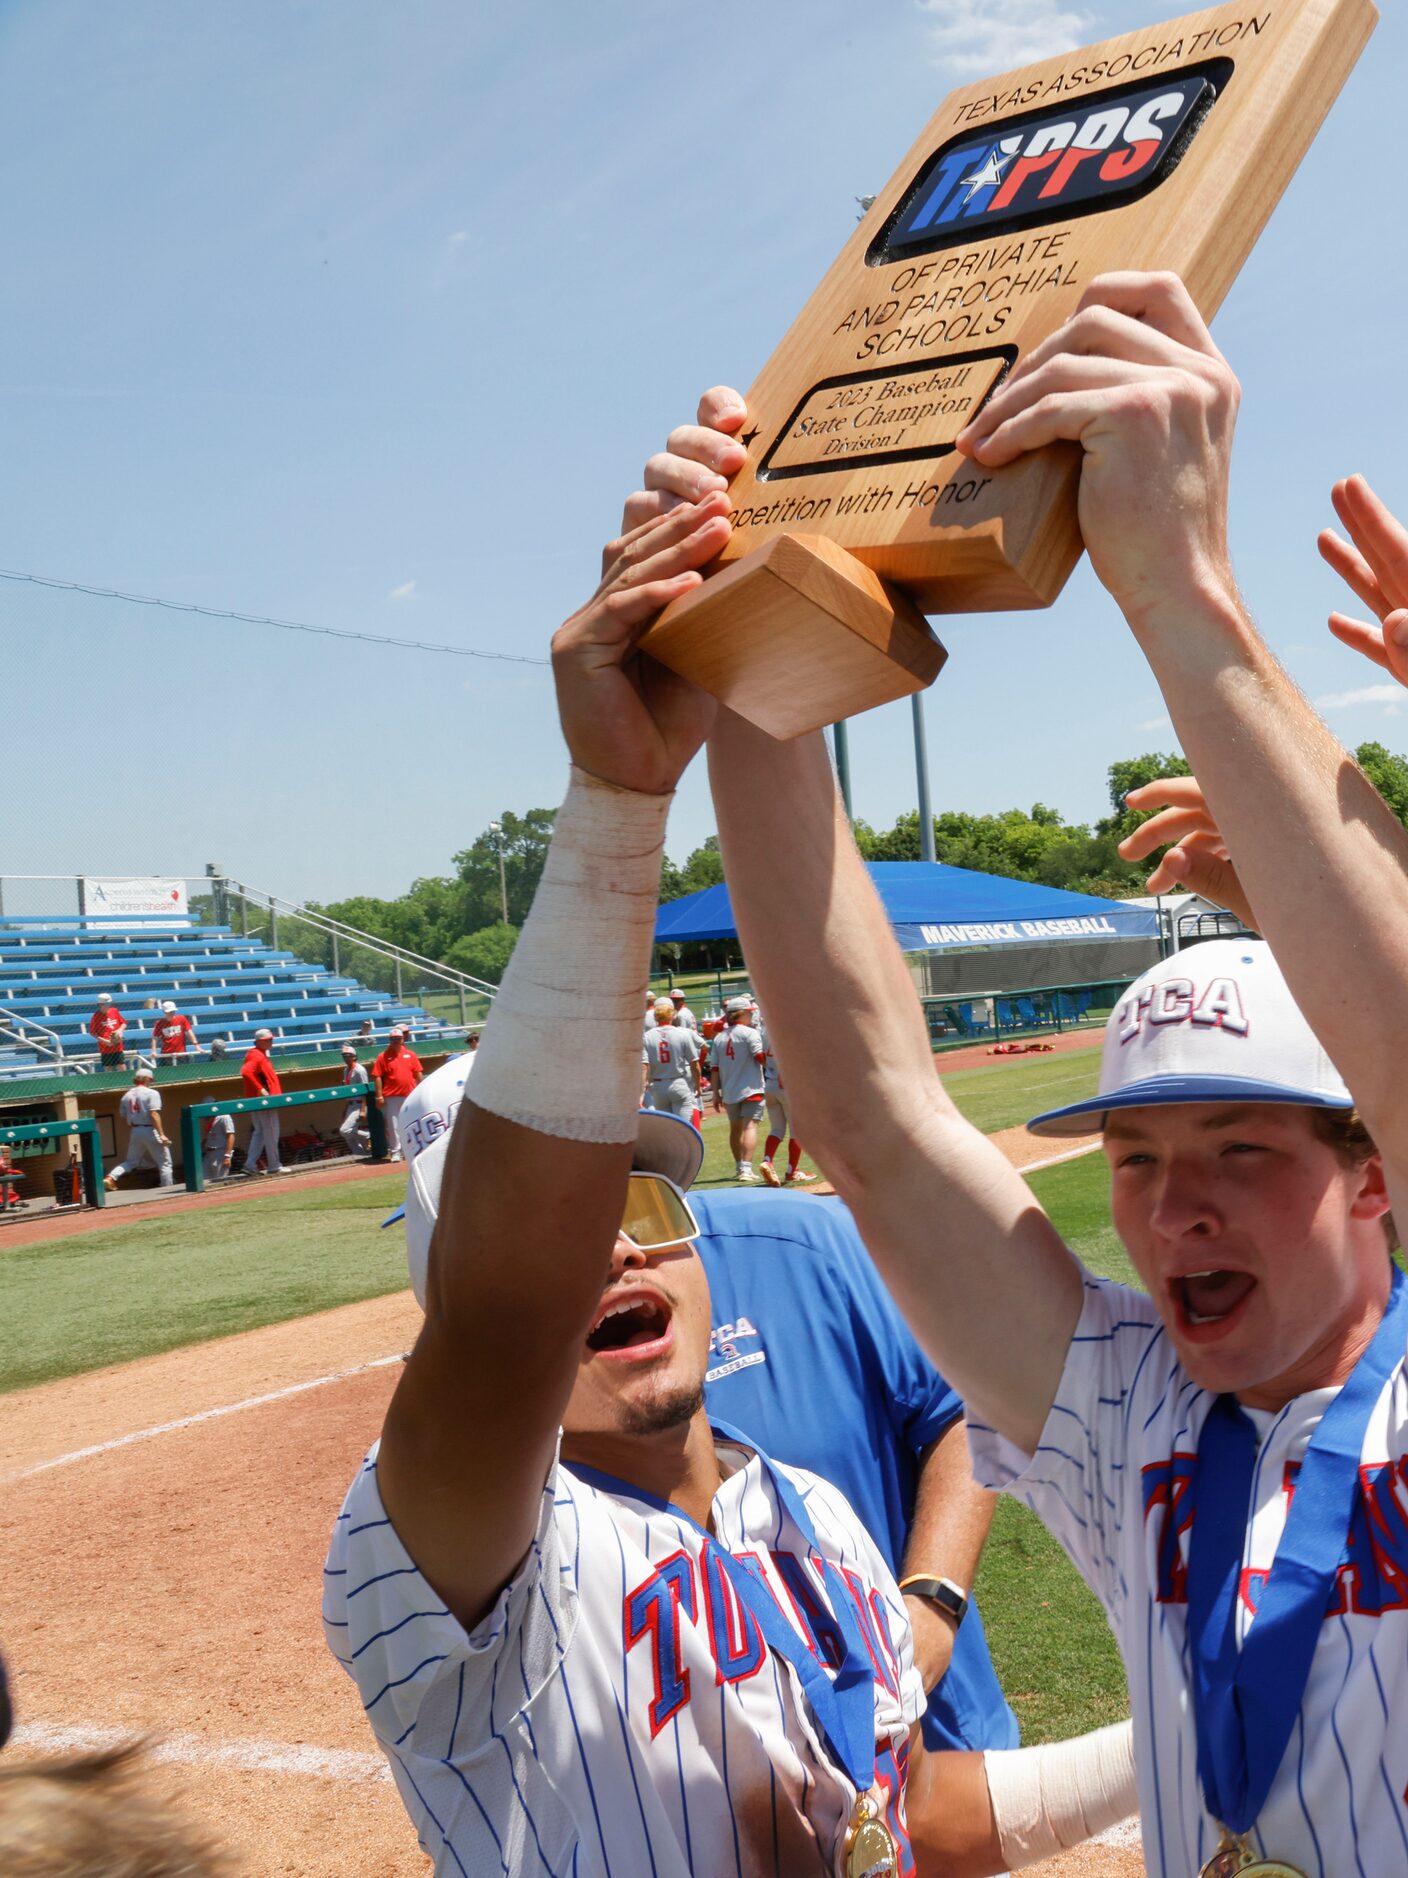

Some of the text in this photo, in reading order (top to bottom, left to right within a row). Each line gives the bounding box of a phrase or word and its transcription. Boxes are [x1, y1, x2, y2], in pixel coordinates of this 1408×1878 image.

[953, 12, 1271, 125] TEXAS ASSOCIATION
[908, 92, 1185, 232] TAPPS
[890, 231, 1071, 294] OF PRIVATE
[833, 260, 1079, 335] AND PAROCHIAL
[856, 306, 1012, 360] SCHOOLS
[826, 367, 973, 410] 2023 Baseball
[792, 393, 973, 439] State Champion
[822, 433, 895, 456] Division
[835, 484, 894, 515] with
[896, 476, 993, 509] Honor
[919, 917, 1117, 944] MAVERICK BASEBALL
[1119, 977, 1249, 1047] TCA
[658, 1041, 671, 1064] 6
[725, 1037, 736, 1061] 4
